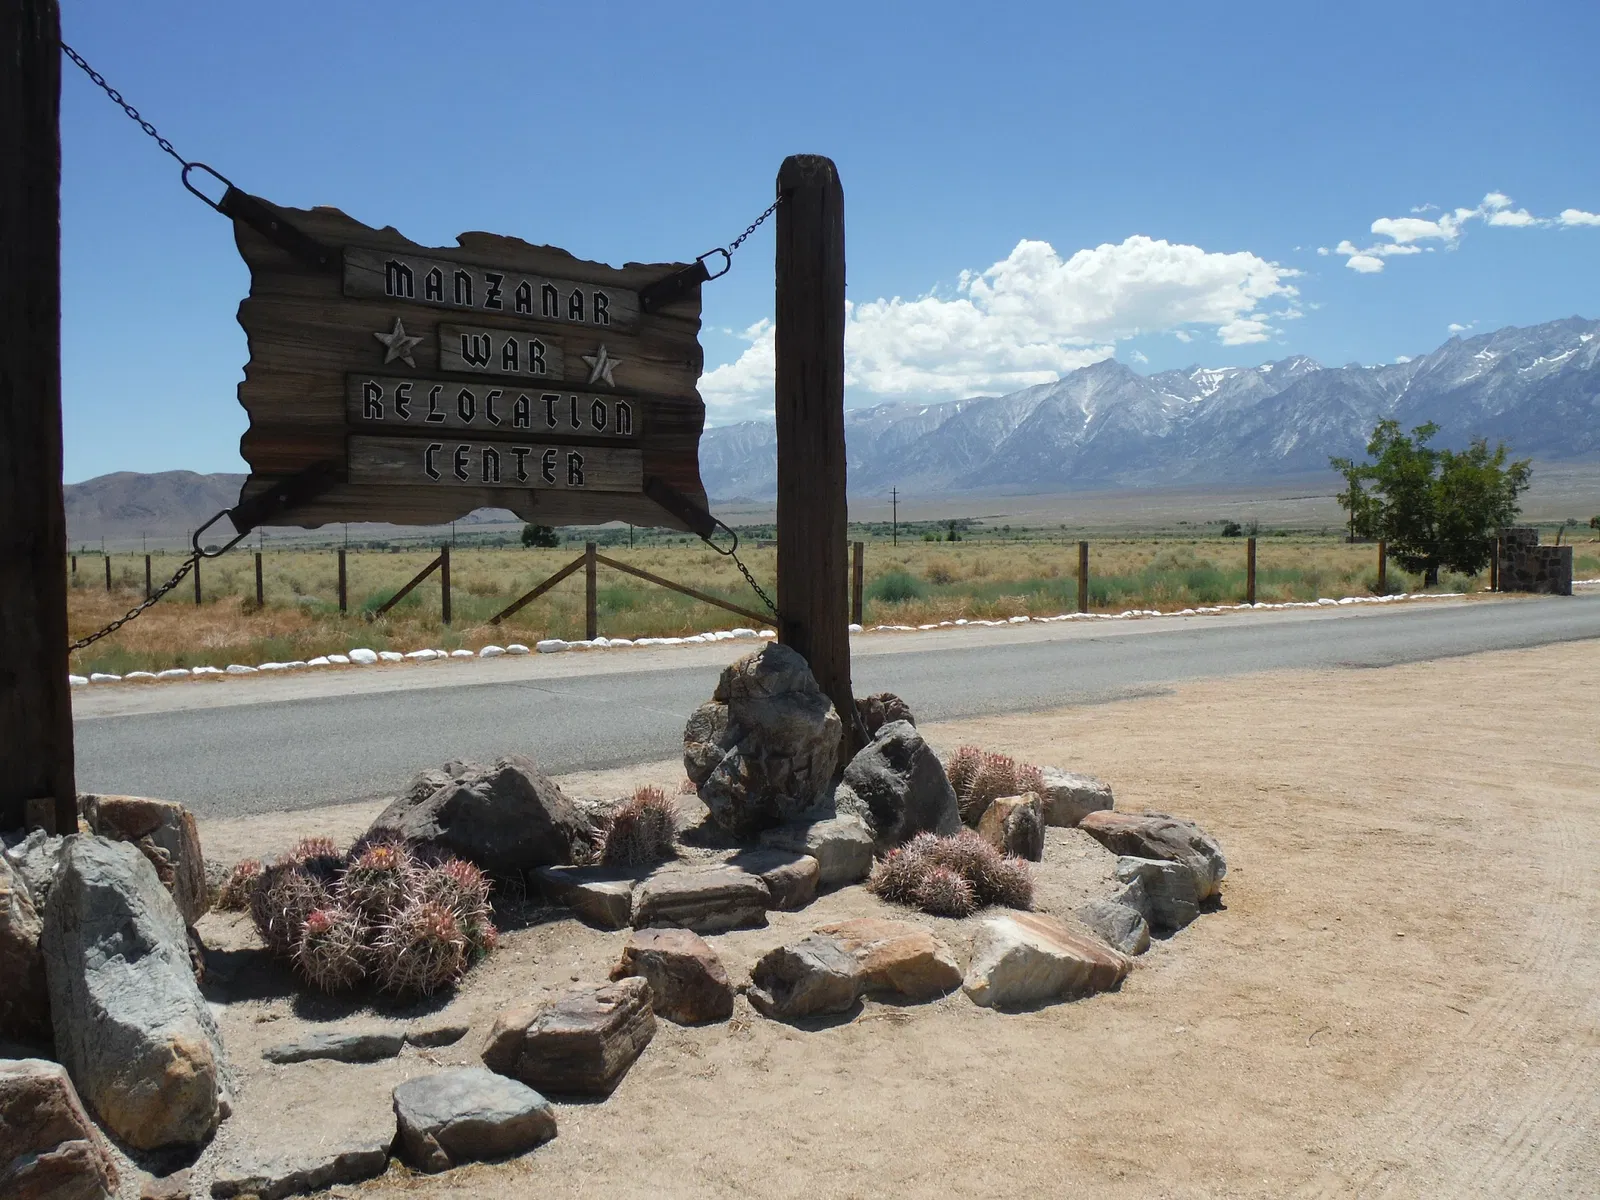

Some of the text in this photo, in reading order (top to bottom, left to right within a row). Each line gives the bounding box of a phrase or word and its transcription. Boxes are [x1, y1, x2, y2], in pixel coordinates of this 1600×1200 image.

[384, 259, 611, 325] MANZANAR
[460, 332, 547, 374] WAR
[362, 380, 632, 435] RELOCATION
[424, 442, 585, 486] CENTER
